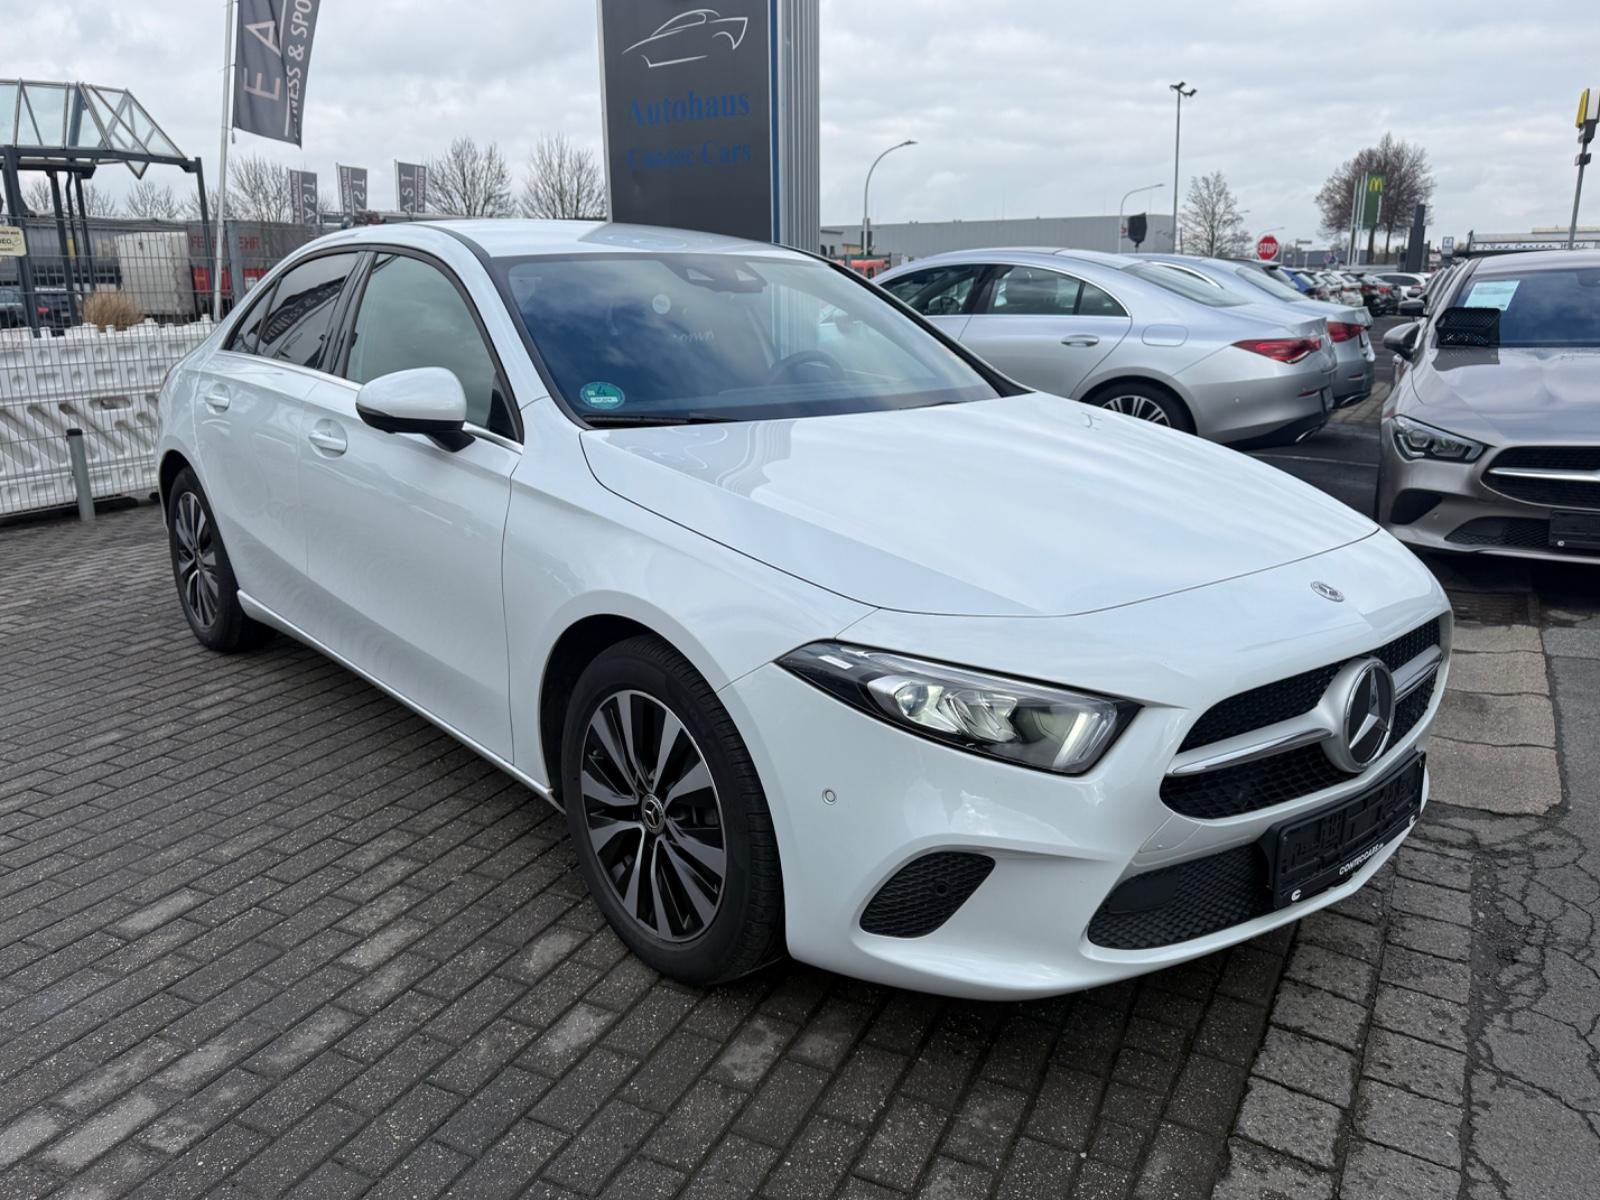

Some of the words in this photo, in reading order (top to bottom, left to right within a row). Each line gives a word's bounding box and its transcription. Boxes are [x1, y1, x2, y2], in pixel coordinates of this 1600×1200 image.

[287, 44, 305, 61] &
[624, 88, 752, 128] Autohaus
[1259, 242, 1278, 254] STOP
